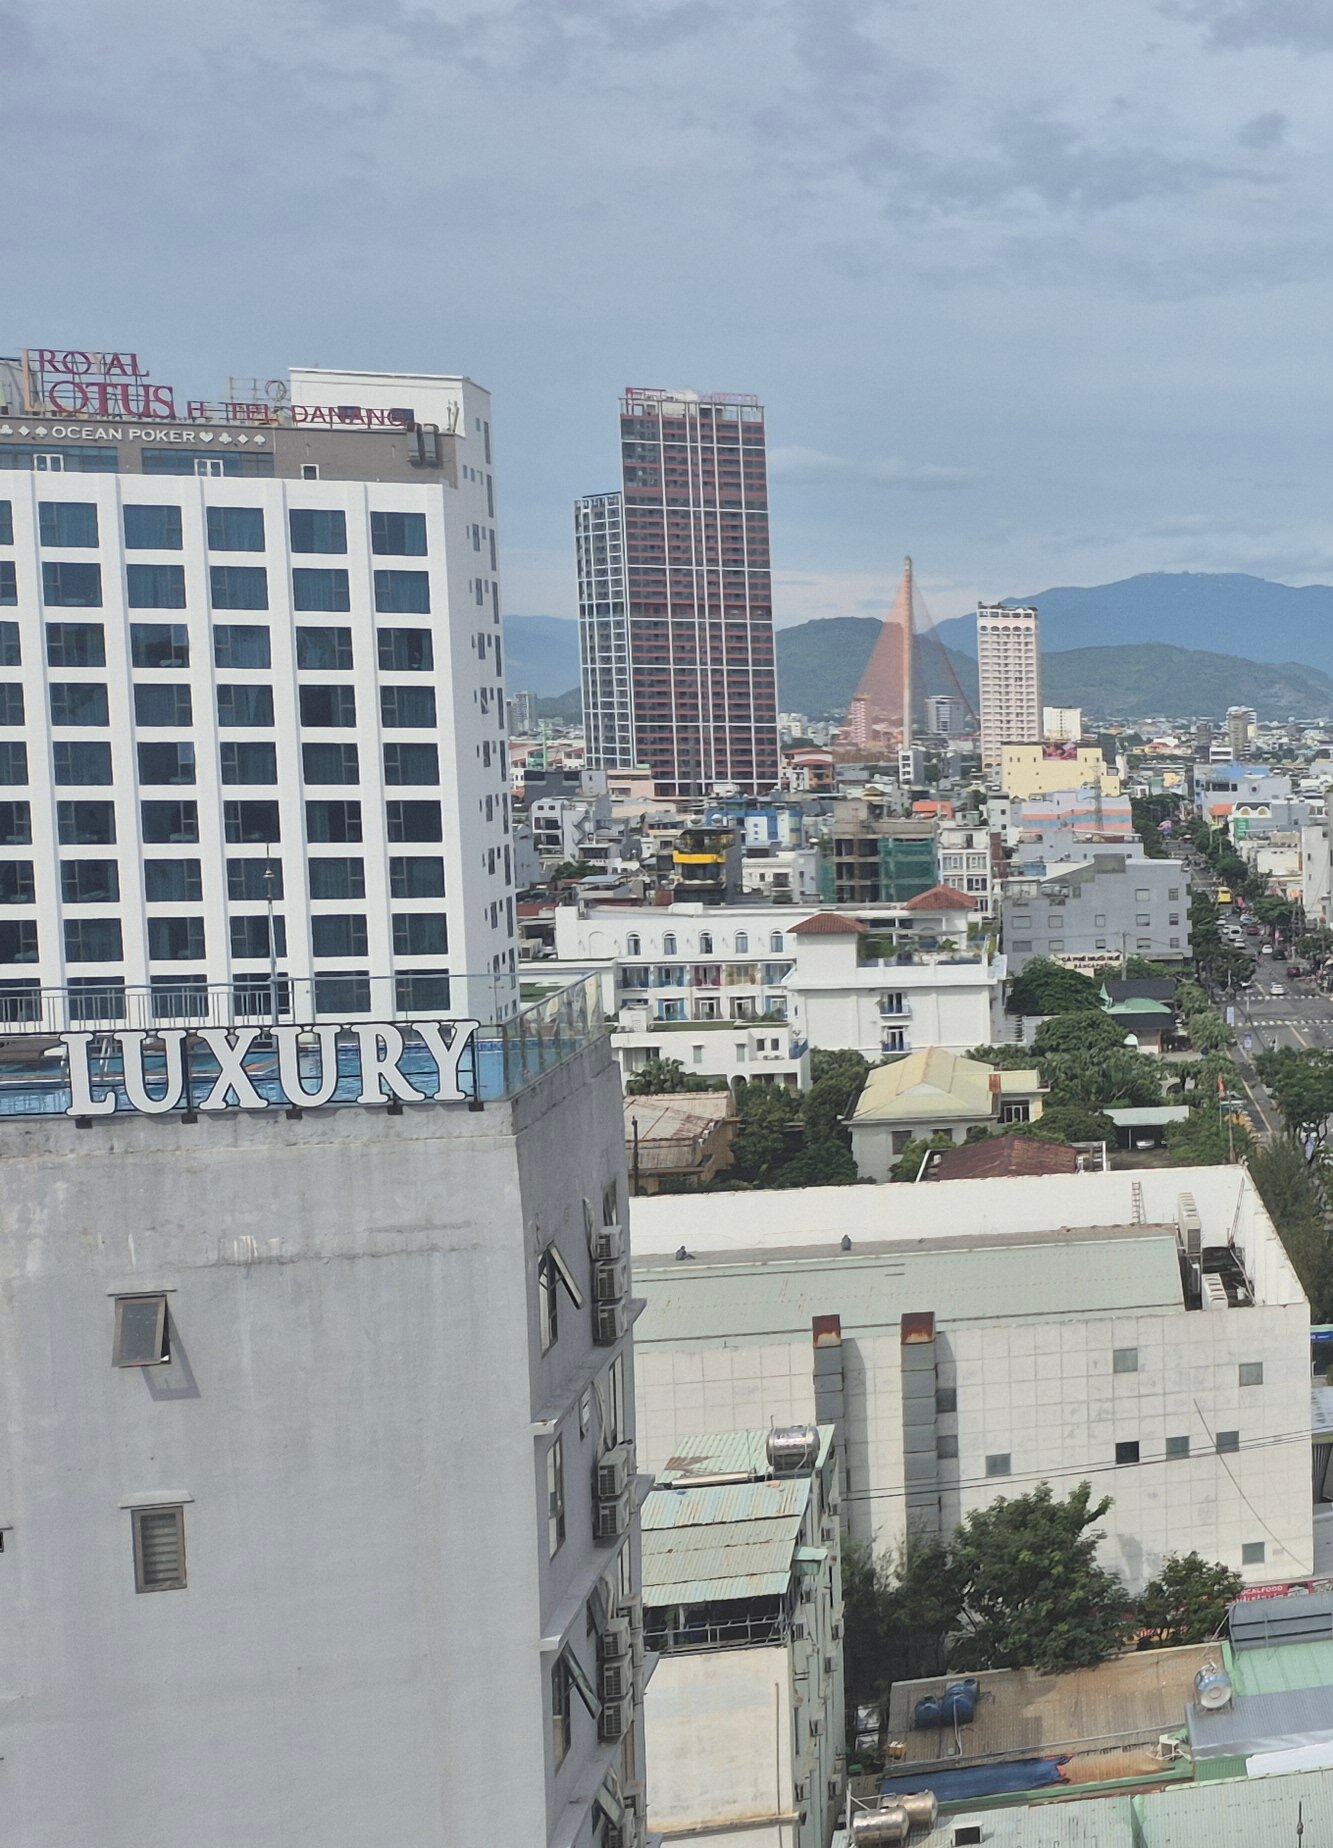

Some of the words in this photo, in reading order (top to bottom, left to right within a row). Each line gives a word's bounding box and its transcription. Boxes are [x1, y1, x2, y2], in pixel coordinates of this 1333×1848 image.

[38, 349, 150, 378] ROYAL
[52, 425, 123, 441] OCEAN
[128, 428, 196, 443] POKER
[59, 1019, 482, 1116] LUXURY
